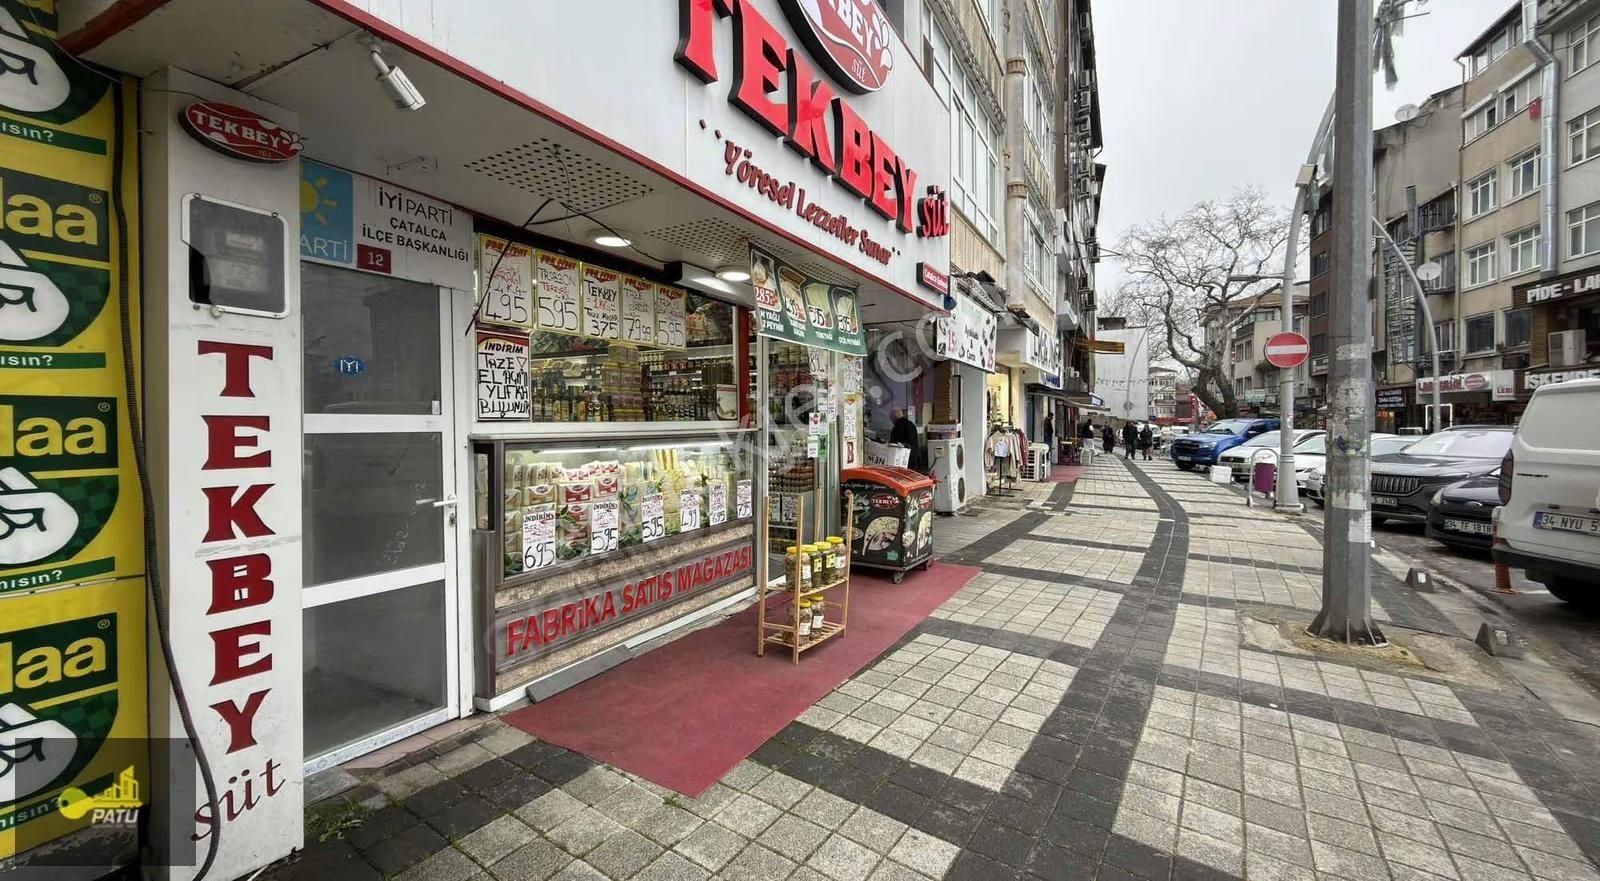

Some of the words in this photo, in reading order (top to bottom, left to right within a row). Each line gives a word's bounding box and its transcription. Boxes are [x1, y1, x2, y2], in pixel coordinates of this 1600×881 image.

[829, 0, 873, 58] BEY
[192, 110, 281, 149] TEKBEY
[673, 0, 918, 234] TEKBEY
[917, 184, 950, 238] süt
[724, 139, 796, 210] Yöresel
[796, 188, 861, 247] Lezzetler
[362, 224, 393, 243] İLÇE
[397, 236, 469, 262] BAŞKANLIĞI
[390, 217, 447, 241] ÇATALCA
[367, 252, 384, 267] 12
[538, 296, 579, 330] 595
[591, 320, 618, 339] 375
[479, 352, 515, 370] TAZE
[484, 341, 524, 355] İNDİRİM
[479, 369, 503, 385] EL
[642, 516, 664, 539] 595
[1542, 514, 1555, 526] 34
[1560, 516, 1583, 530] NYU
[198, 340, 276, 755] TEKBEY
[592, 527, 619, 552] 595
[524, 541, 555, 569] 695
[676, 546, 752, 593] MAĞAZASI
[190, 757, 287, 842] süt
